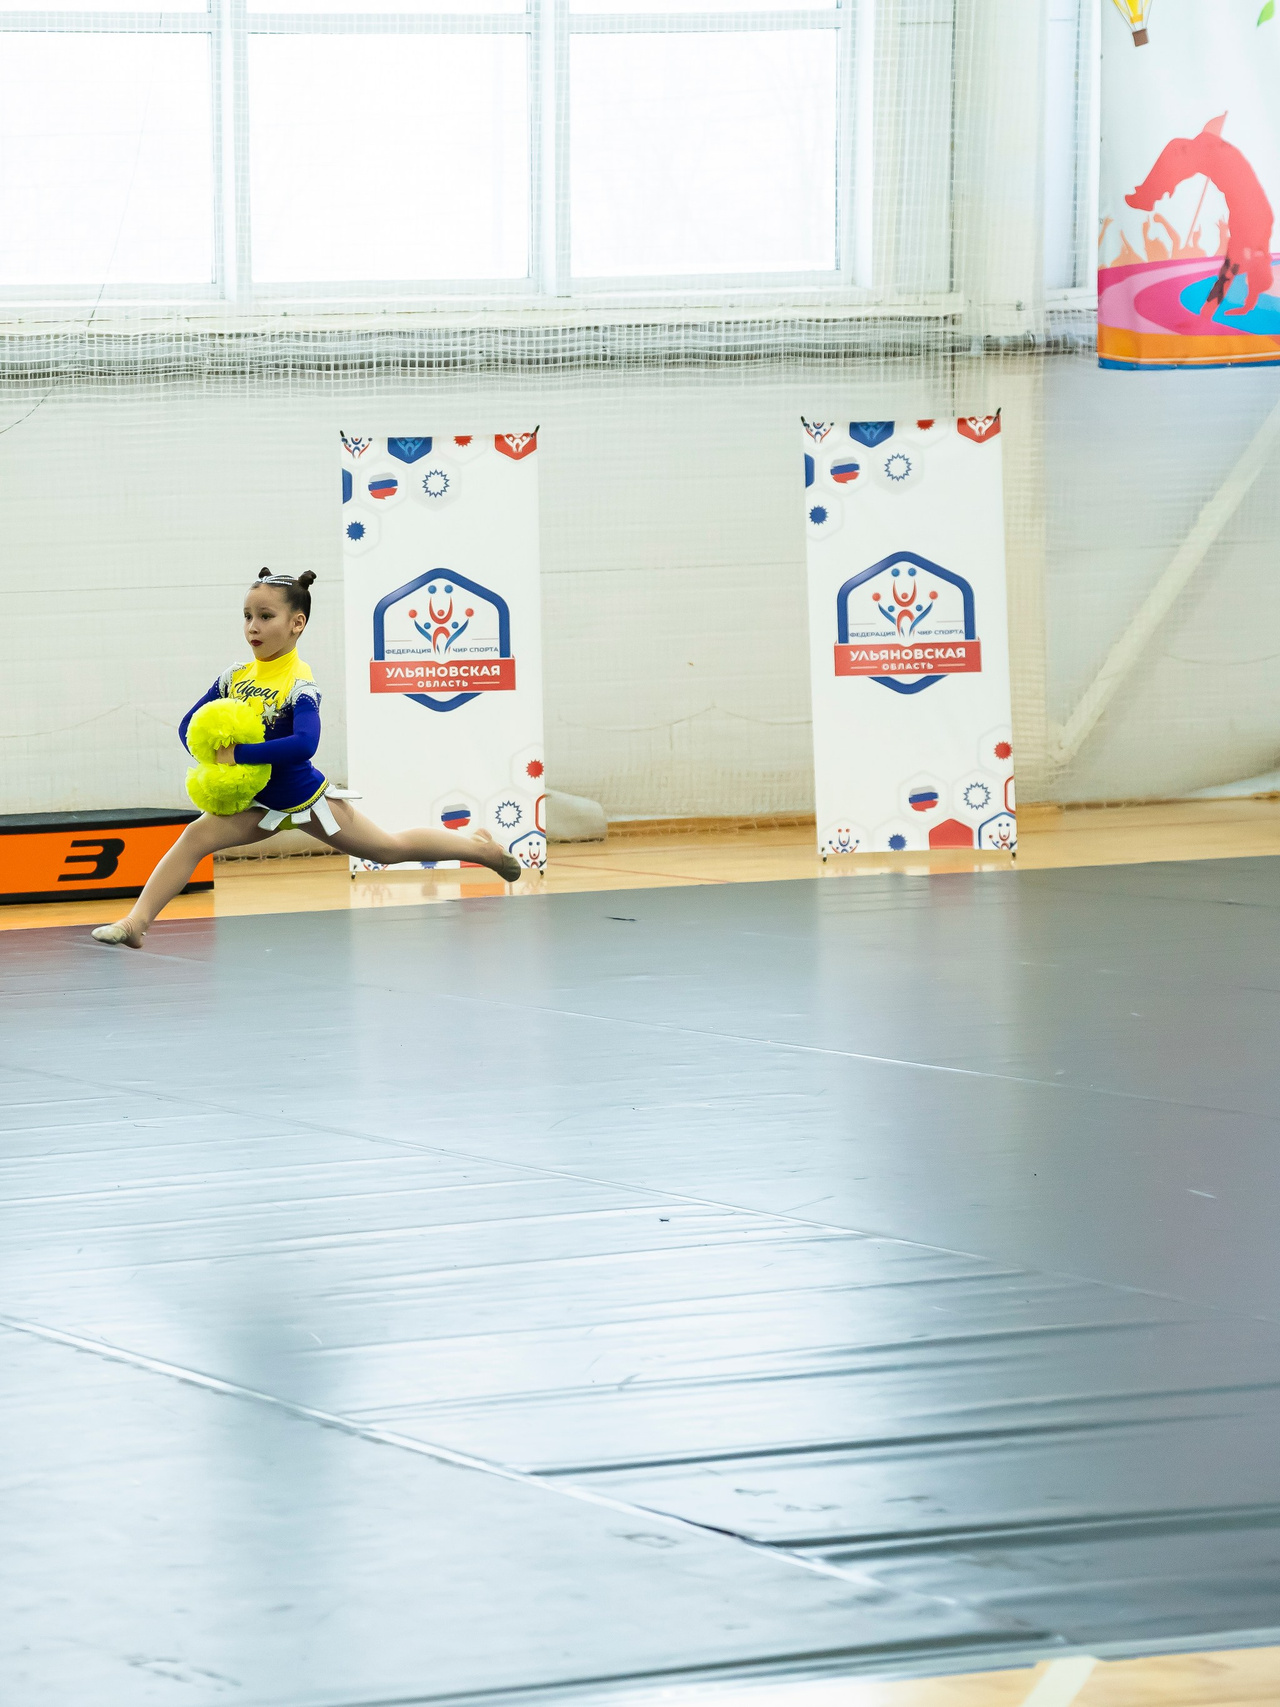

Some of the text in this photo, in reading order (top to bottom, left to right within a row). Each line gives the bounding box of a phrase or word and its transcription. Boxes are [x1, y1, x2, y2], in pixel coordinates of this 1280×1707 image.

[849, 647, 966, 662] УЛЬЯНОВСКАЯ
[385, 665, 501, 679] УЛЬЯНОВСКАЯ
[881, 662, 934, 671] ОБЛАСТЬ
[417, 680, 469, 688] ОБЛАСТЬ
[57, 838, 126, 882] 3
